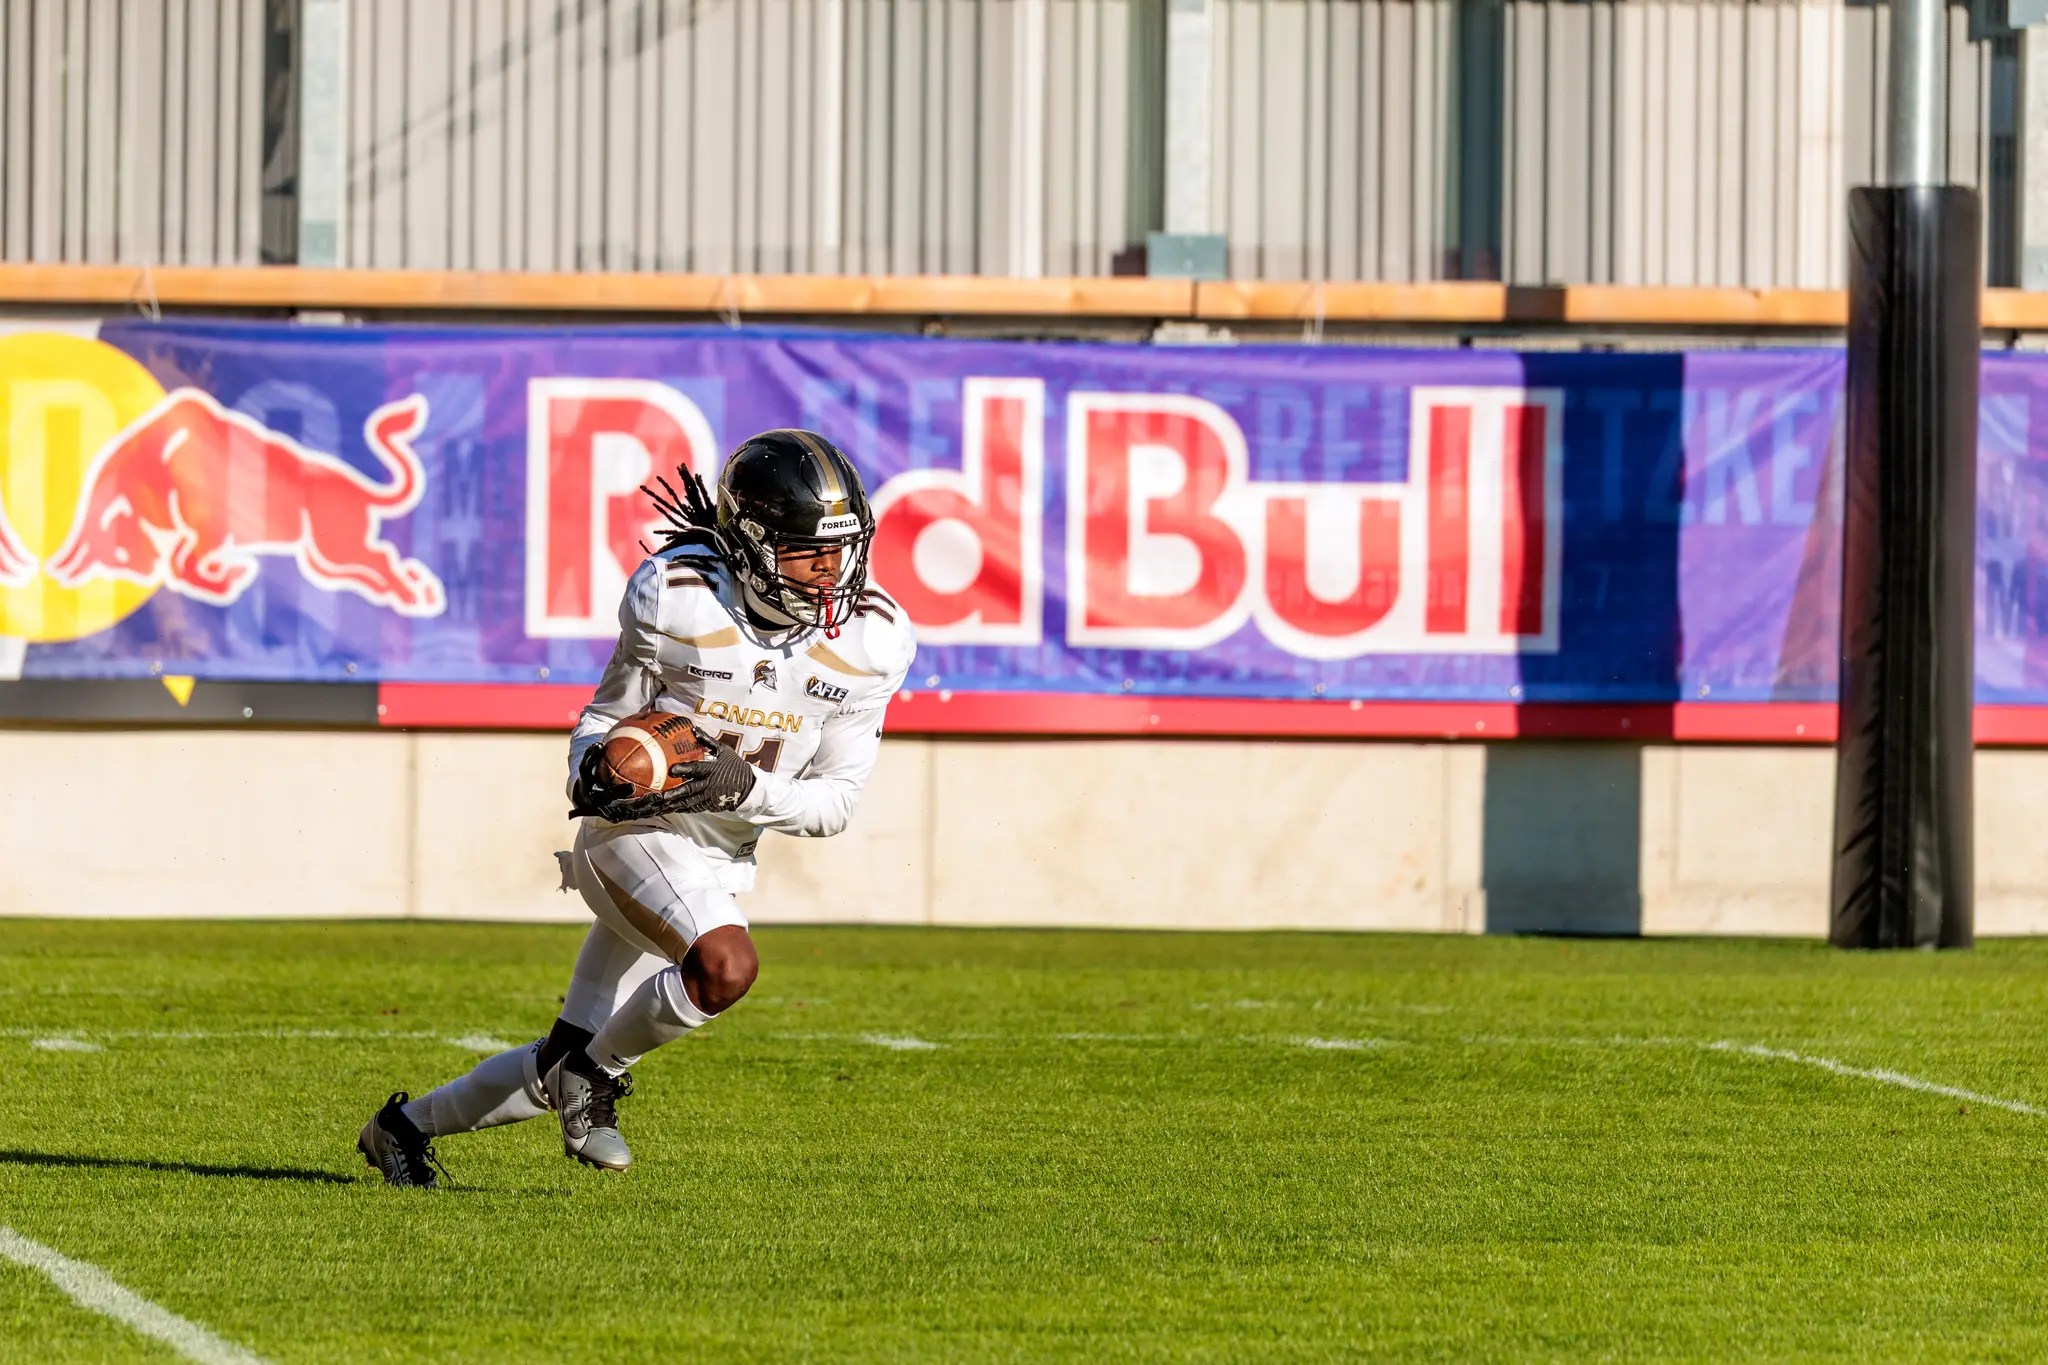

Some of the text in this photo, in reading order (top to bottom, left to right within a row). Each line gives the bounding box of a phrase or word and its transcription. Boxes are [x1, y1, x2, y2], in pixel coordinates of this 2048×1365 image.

[526, 376, 1564, 659] Rd Bull
[821, 518, 858, 530] FORELLE
[809, 680, 849, 701] AFLE
[695, 697, 803, 733] LONDON
